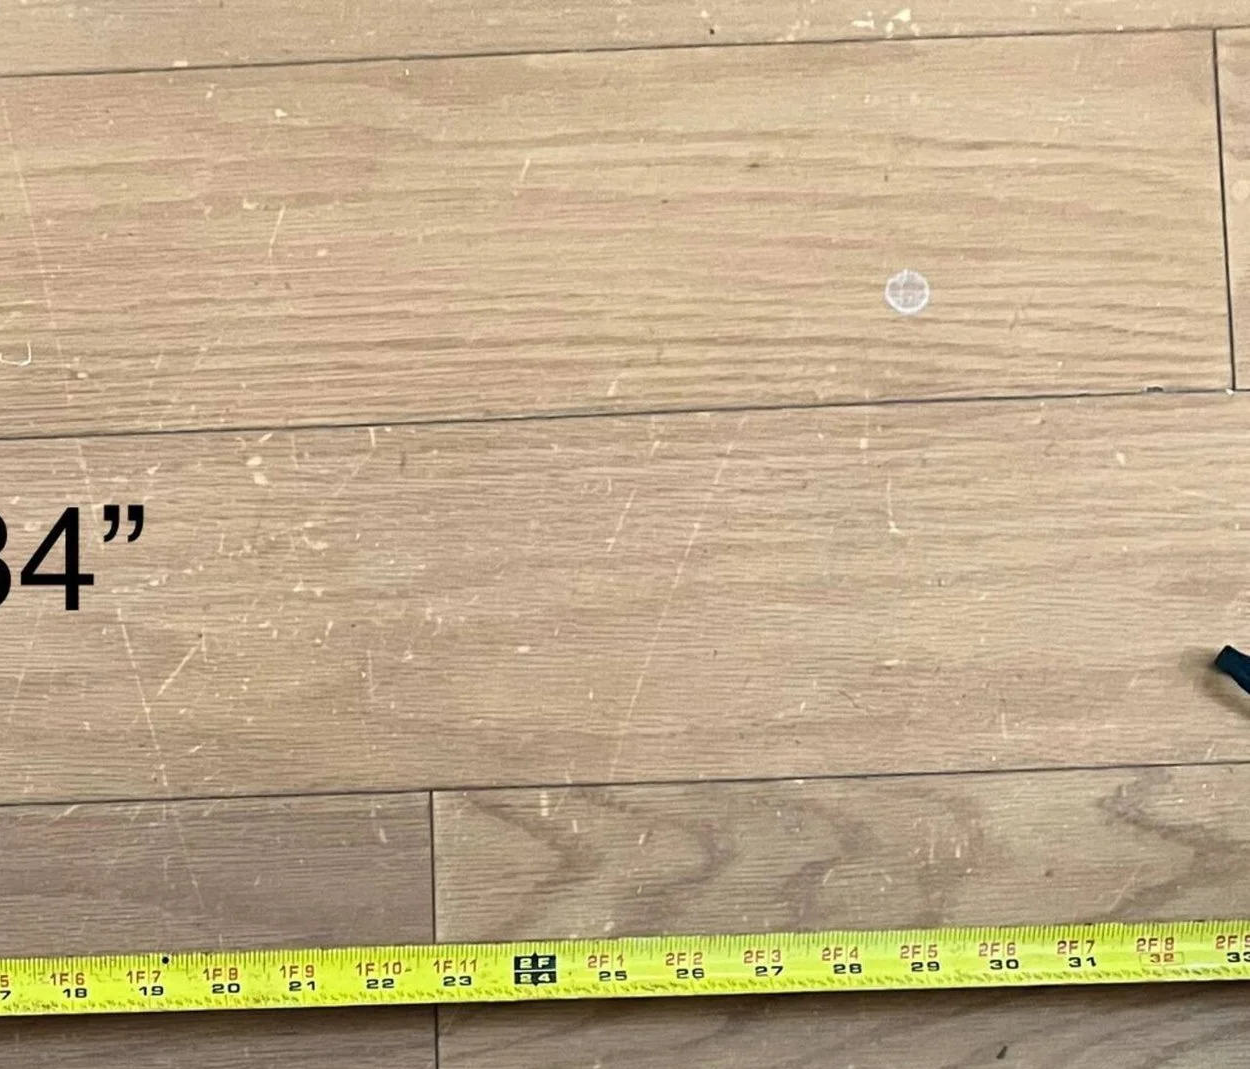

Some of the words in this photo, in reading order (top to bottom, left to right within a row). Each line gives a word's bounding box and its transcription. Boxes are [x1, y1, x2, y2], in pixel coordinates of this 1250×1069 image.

[1069, 957, 1096, 967] 31
[1150, 953, 1174, 963] 32
[520, 958, 549, 969] 2F
[911, 961, 940, 972] 29
[990, 959, 1019, 970] 30
[676, 968, 705, 979] 26
[755, 966, 783, 976] 27
[833, 964, 862, 974] 28
[443, 976, 472, 986] 23
[520, 973, 550, 983] 24
[599, 971, 627, 981] 25
[212, 983, 240, 993] 20
[289, 981, 315, 991] 21
[366, 978, 394, 989] 22
[62, 988, 87, 998] 18
[139, 986, 164, 996] 19
